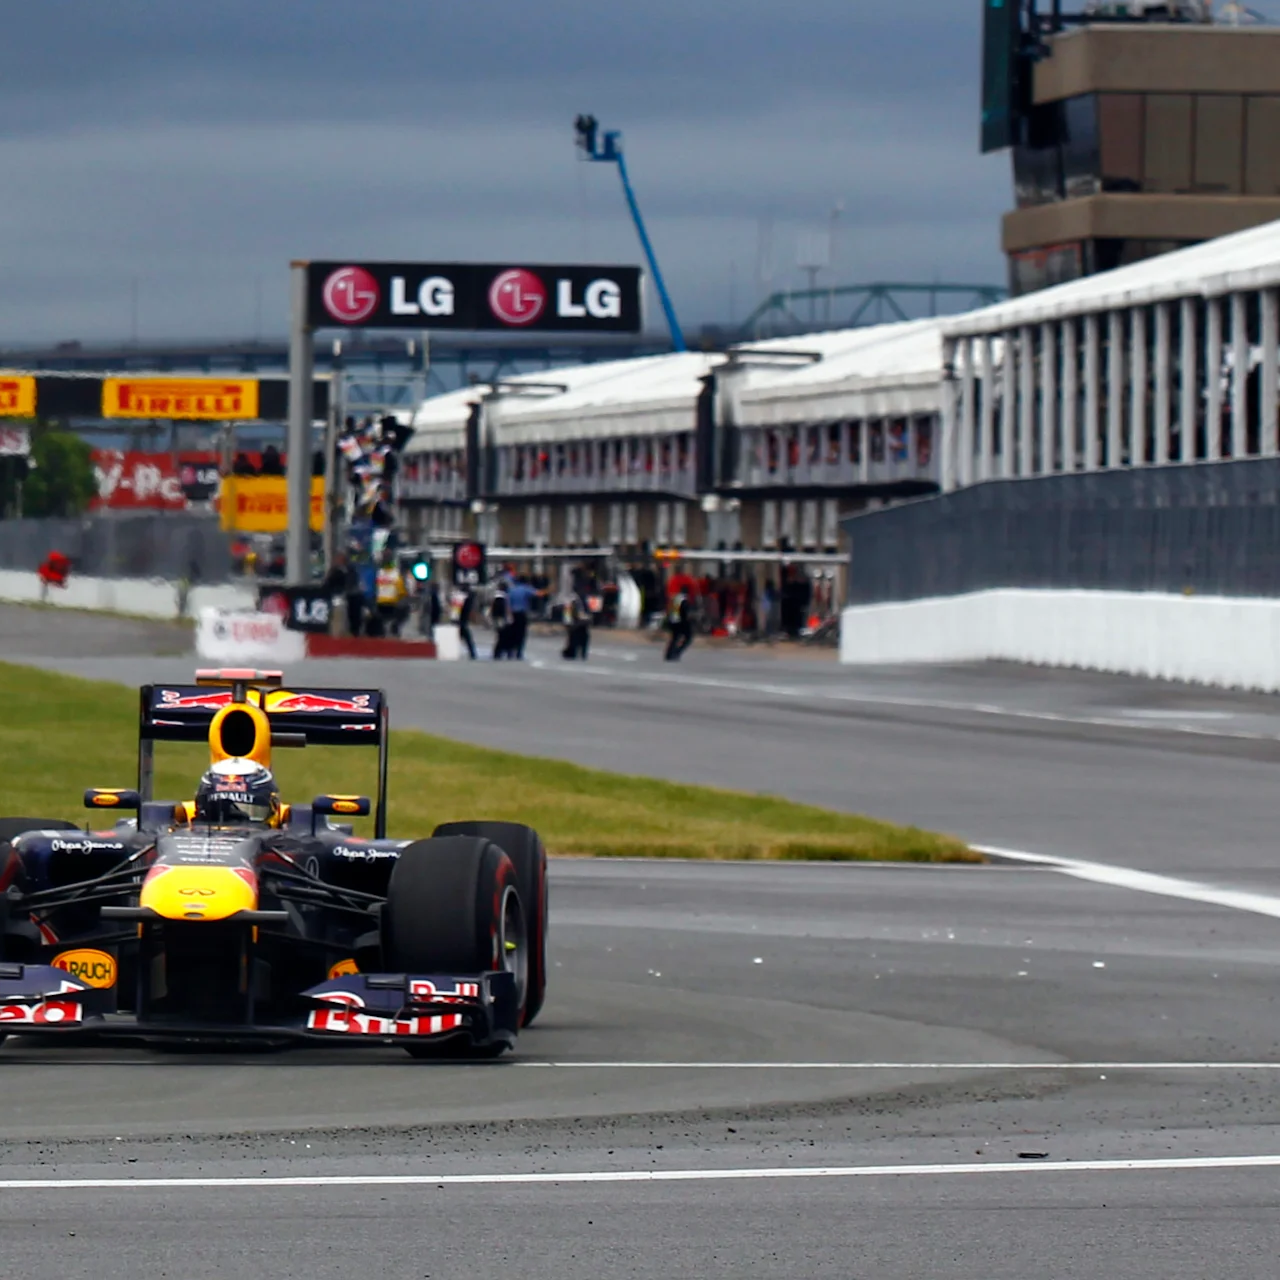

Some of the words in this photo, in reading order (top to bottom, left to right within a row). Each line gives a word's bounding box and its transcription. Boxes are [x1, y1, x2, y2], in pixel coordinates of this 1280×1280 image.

[391, 276, 455, 316] LG
[557, 279, 621, 318] LG
[118, 384, 242, 412] PIRELLI
[295, 599, 329, 621] LG
[69, 960, 112, 980] RAUCH
